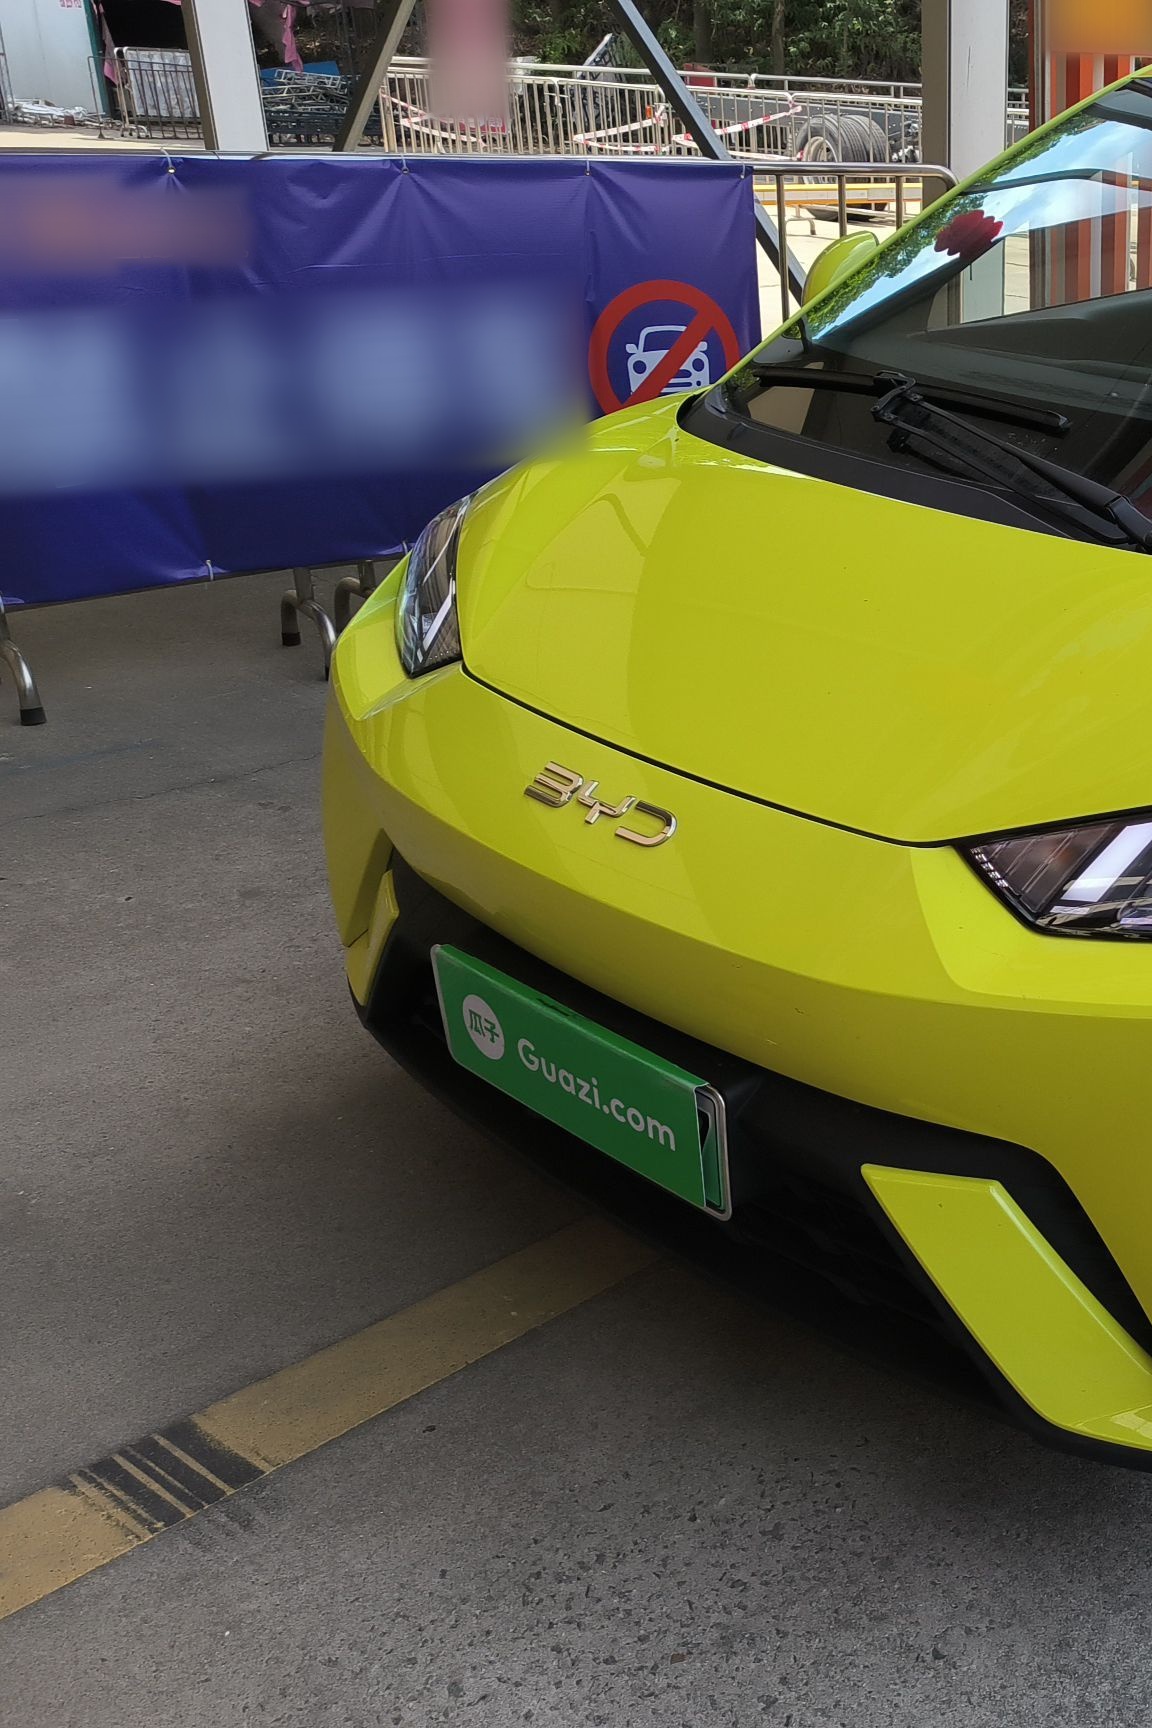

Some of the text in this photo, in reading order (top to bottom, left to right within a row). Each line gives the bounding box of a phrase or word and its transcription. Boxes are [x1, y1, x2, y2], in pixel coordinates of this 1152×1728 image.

[524, 761, 678, 848] BYD
[469, 1008, 500, 1044] 瓜子
[517, 1038, 676, 1151] Guazi.com
